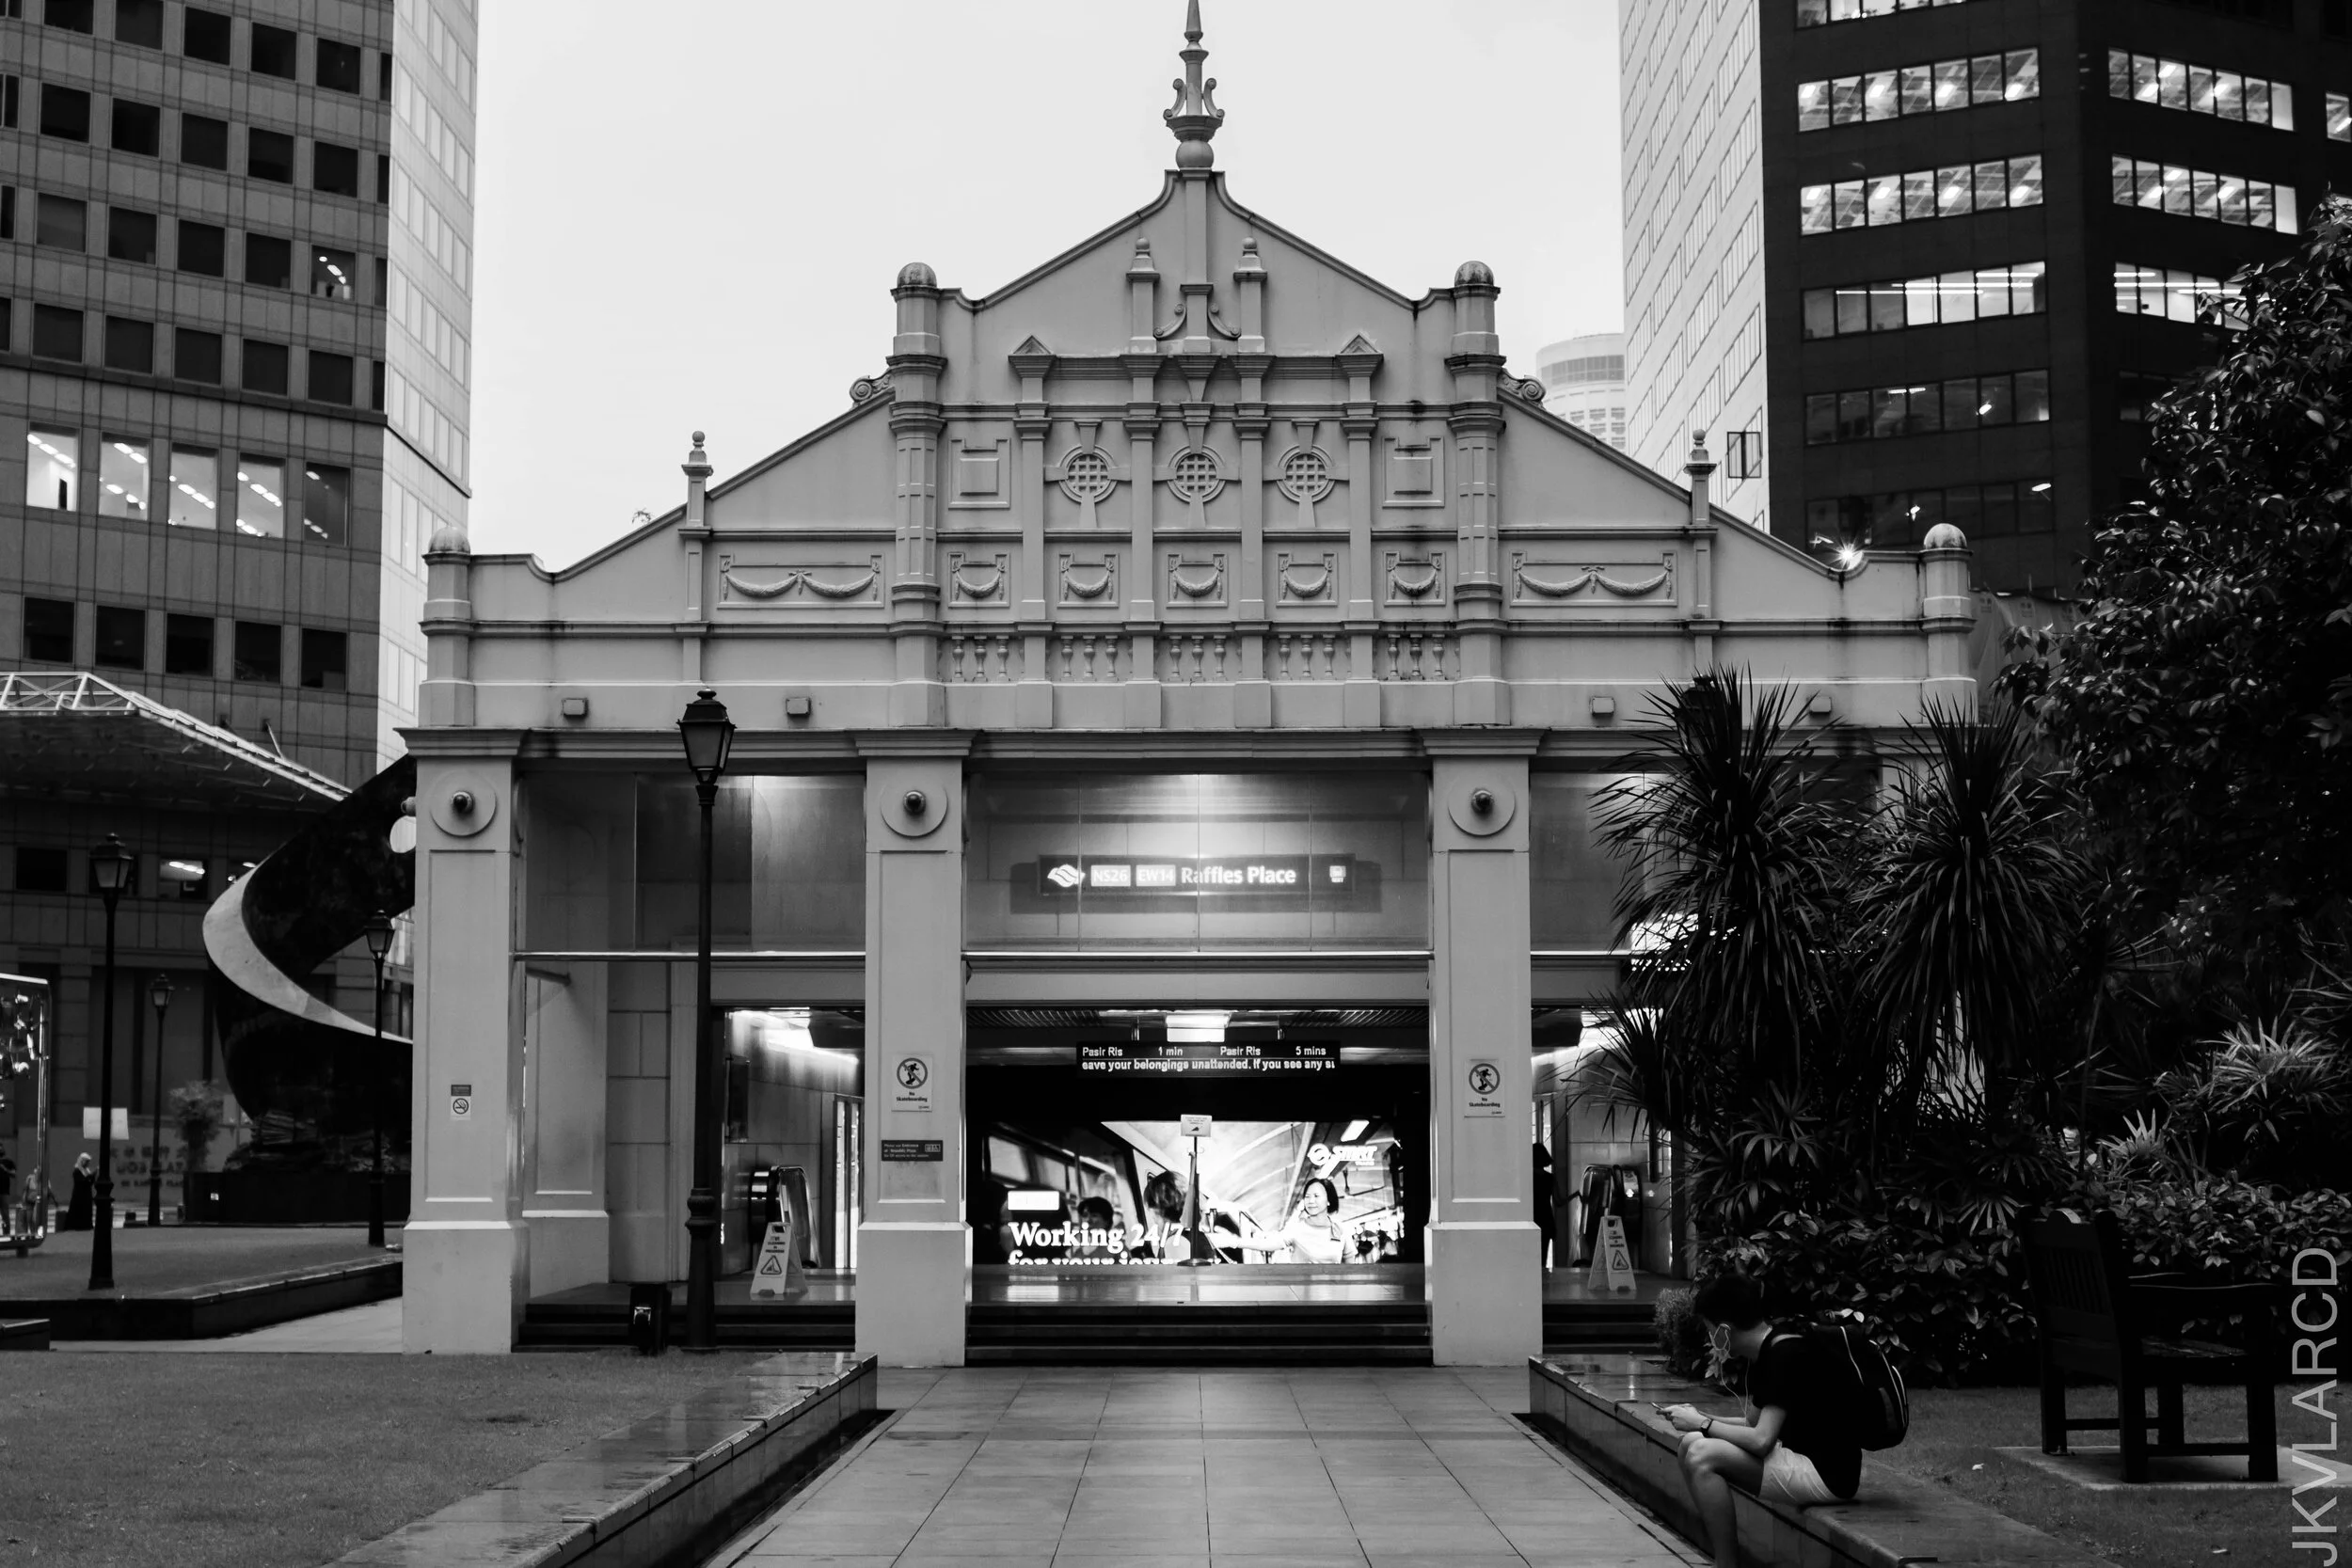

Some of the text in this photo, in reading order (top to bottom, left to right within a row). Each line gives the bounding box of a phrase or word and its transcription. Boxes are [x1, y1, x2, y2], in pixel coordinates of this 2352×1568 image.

[1093, 865, 1296, 884] NS26 EW14 Raffles Place
[1082, 1046, 1184, 1056] Pasir Ris 1 min
[1220, 1045, 1327, 1055] Pasir Ris 5 mins
[1108, 1060, 1132, 1072] your
[1134, 1058, 1189, 1072] belongings
[1191, 1058, 1252, 1069] unattended.
[1253, 1058, 1261, 1069] If
[1262, 1060, 1281, 1071] you
[1283, 1060, 1302, 1069] see
[1304, 1060, 1323, 1071] any
[1008, 1221, 1184, 1254] Working 24/7
